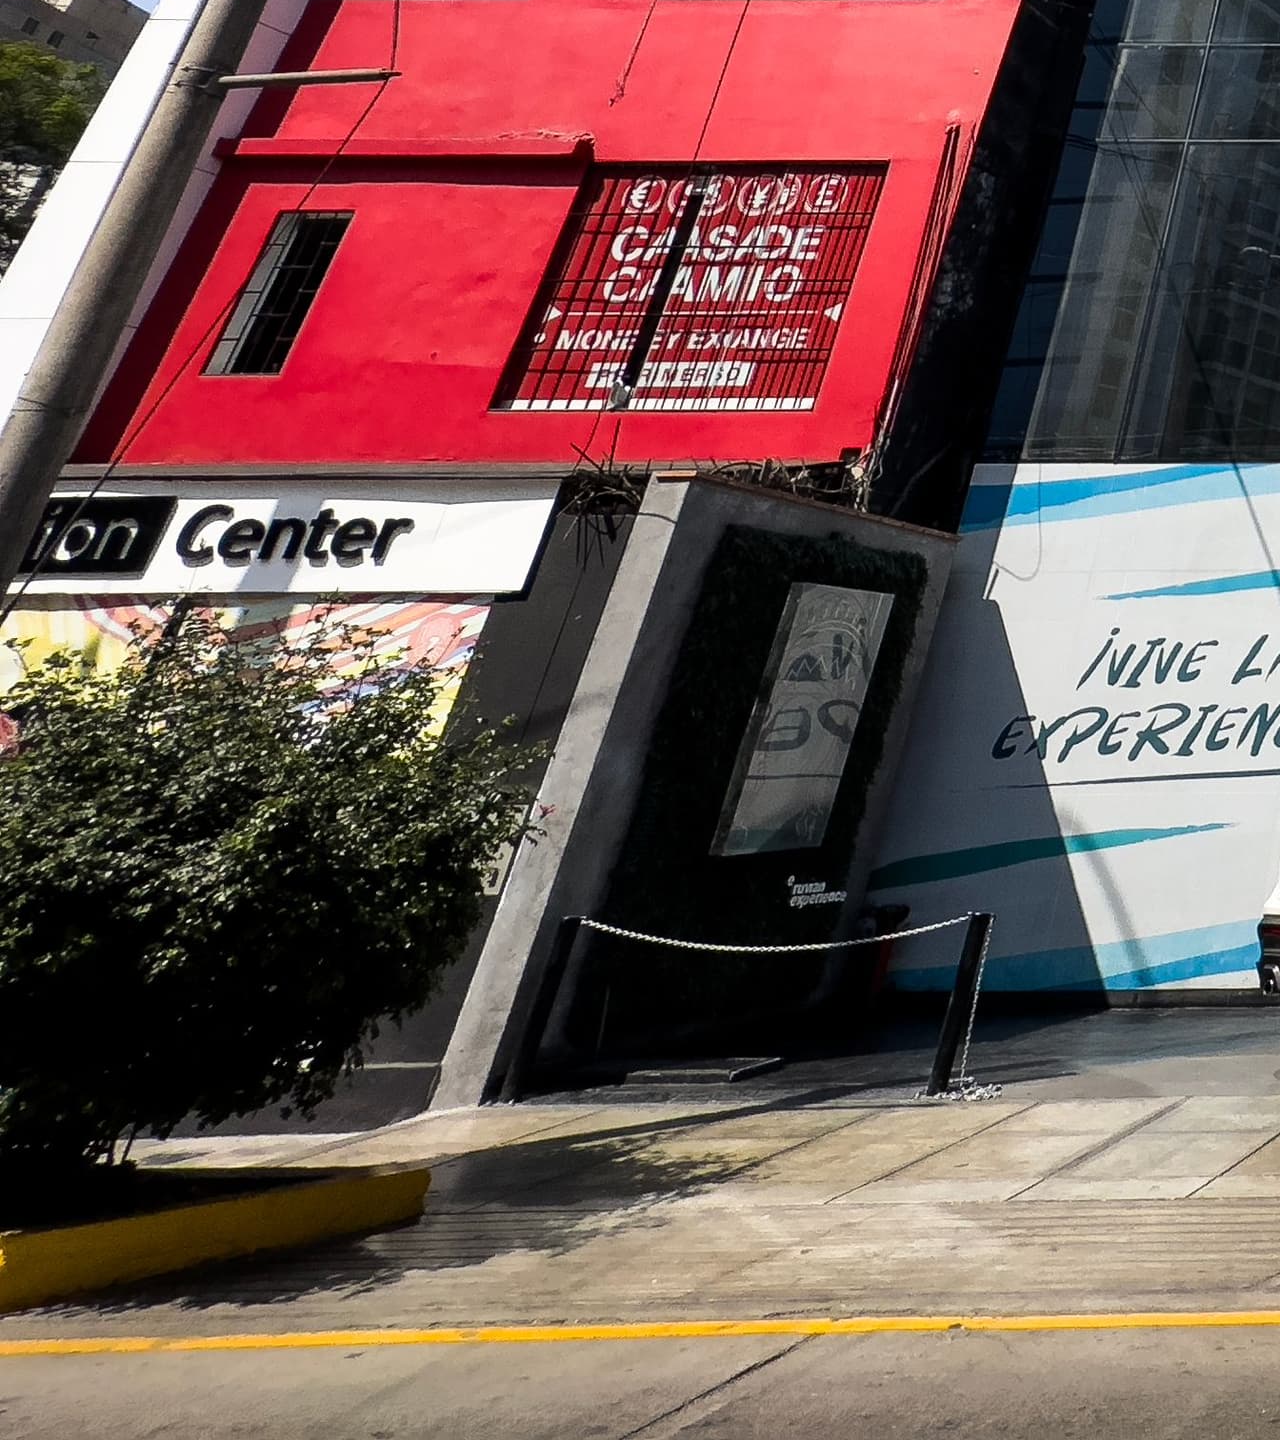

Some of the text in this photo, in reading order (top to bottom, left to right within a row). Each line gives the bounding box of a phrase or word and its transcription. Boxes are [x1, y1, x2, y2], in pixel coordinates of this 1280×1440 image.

[602, 264, 803, 304] CAMIO
[31, 503, 415, 568] ion Center
[1077, 627, 1219, 691] ¡VIVE
